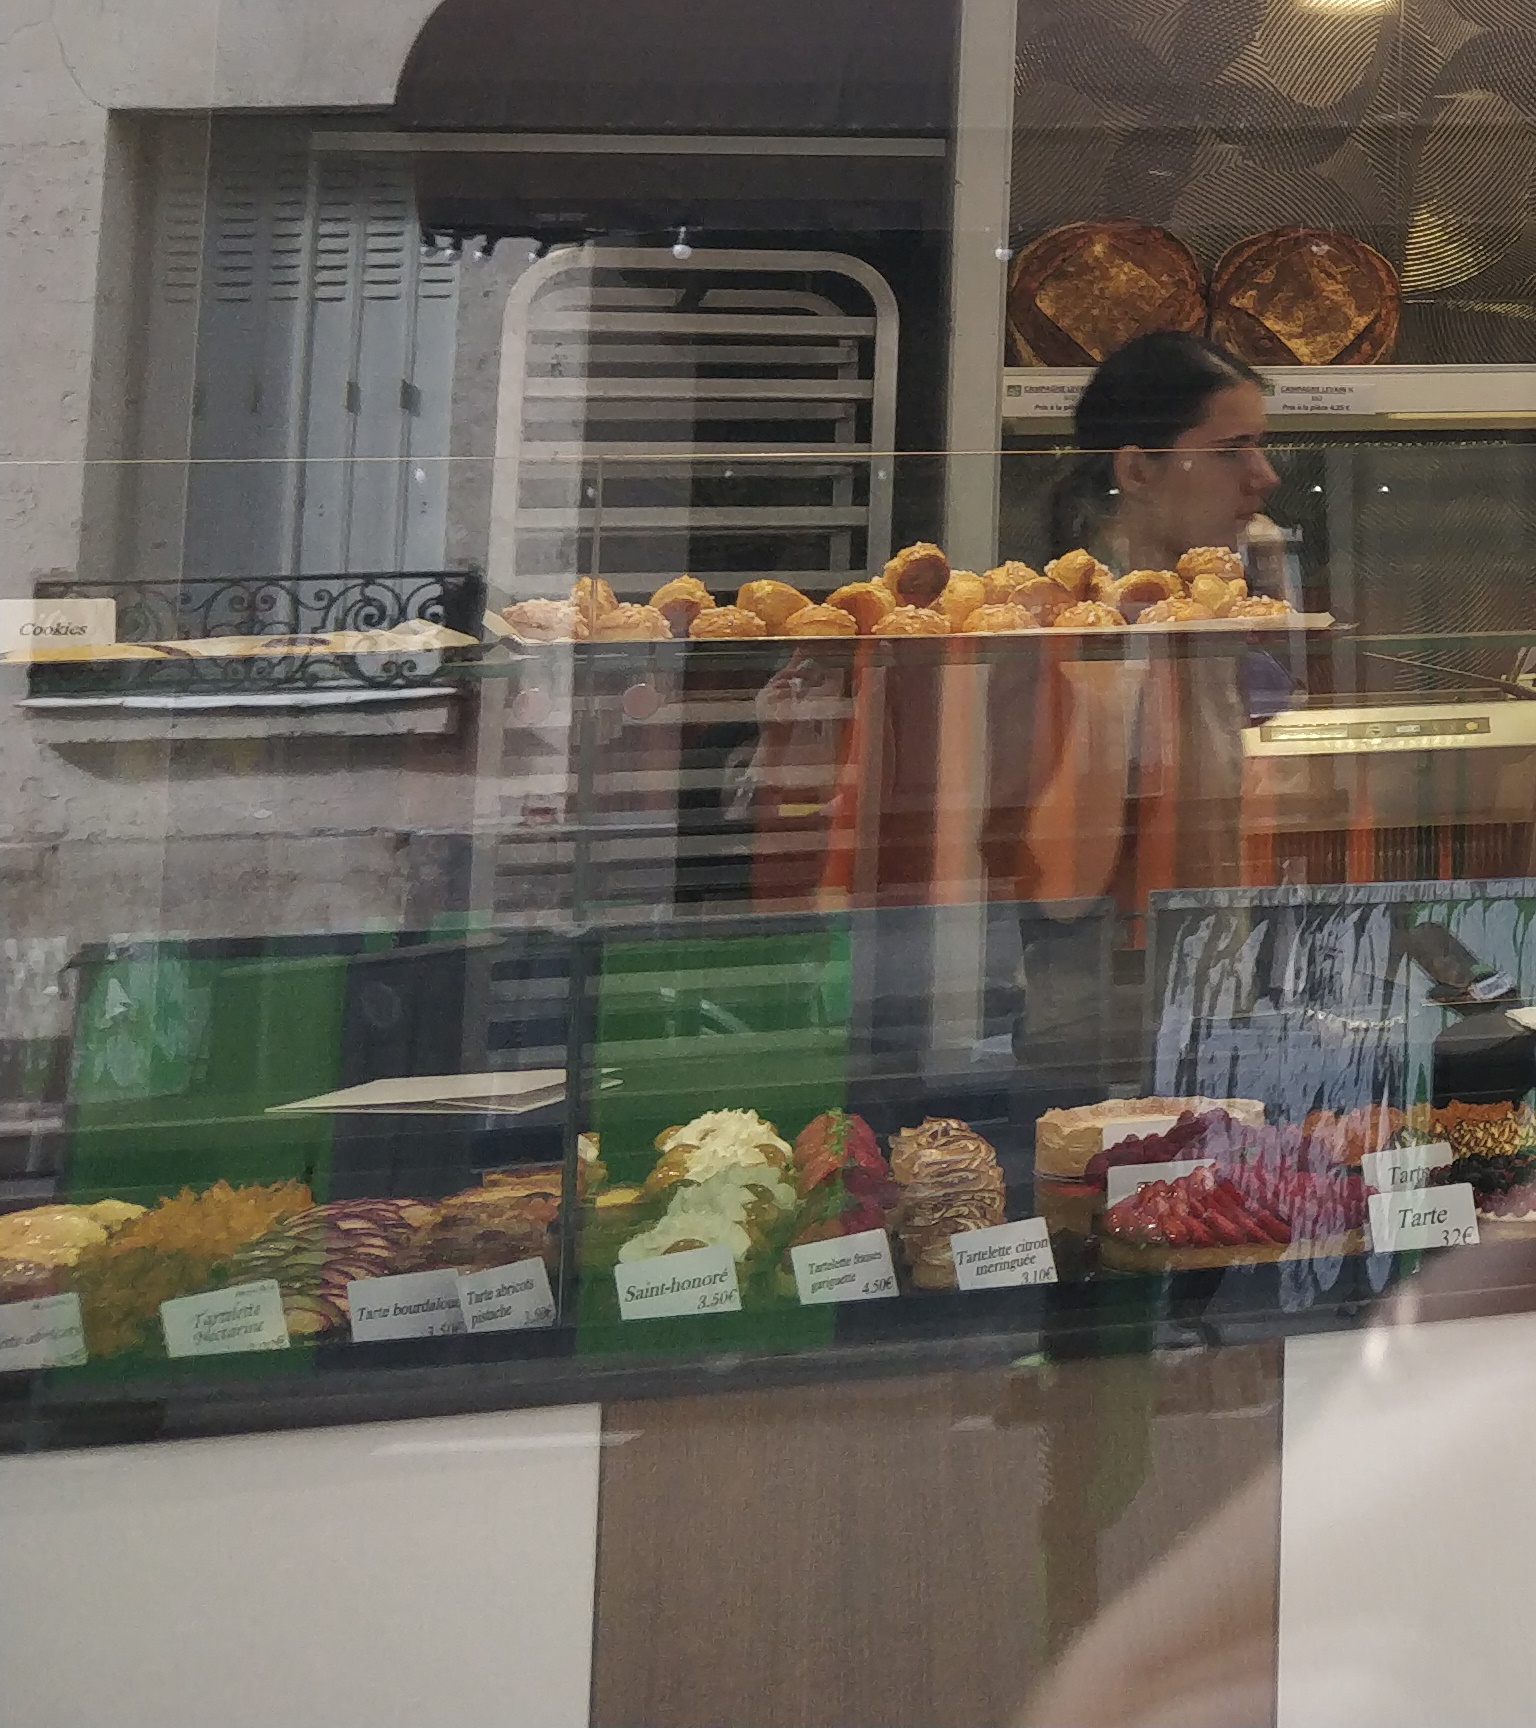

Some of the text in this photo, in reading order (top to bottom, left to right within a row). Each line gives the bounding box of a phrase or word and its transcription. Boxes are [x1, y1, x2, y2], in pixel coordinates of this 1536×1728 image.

[20, 621, 88, 636] Cookies
[1398, 1205, 1448, 1229] Tarte
[957, 1238, 1048, 1266] Tartelette citron
[975, 1253, 1037, 1276] meringuée
[624, 1268, 729, 1303] Saint-honoré
[358, 1307, 390, 1321] Tarte
